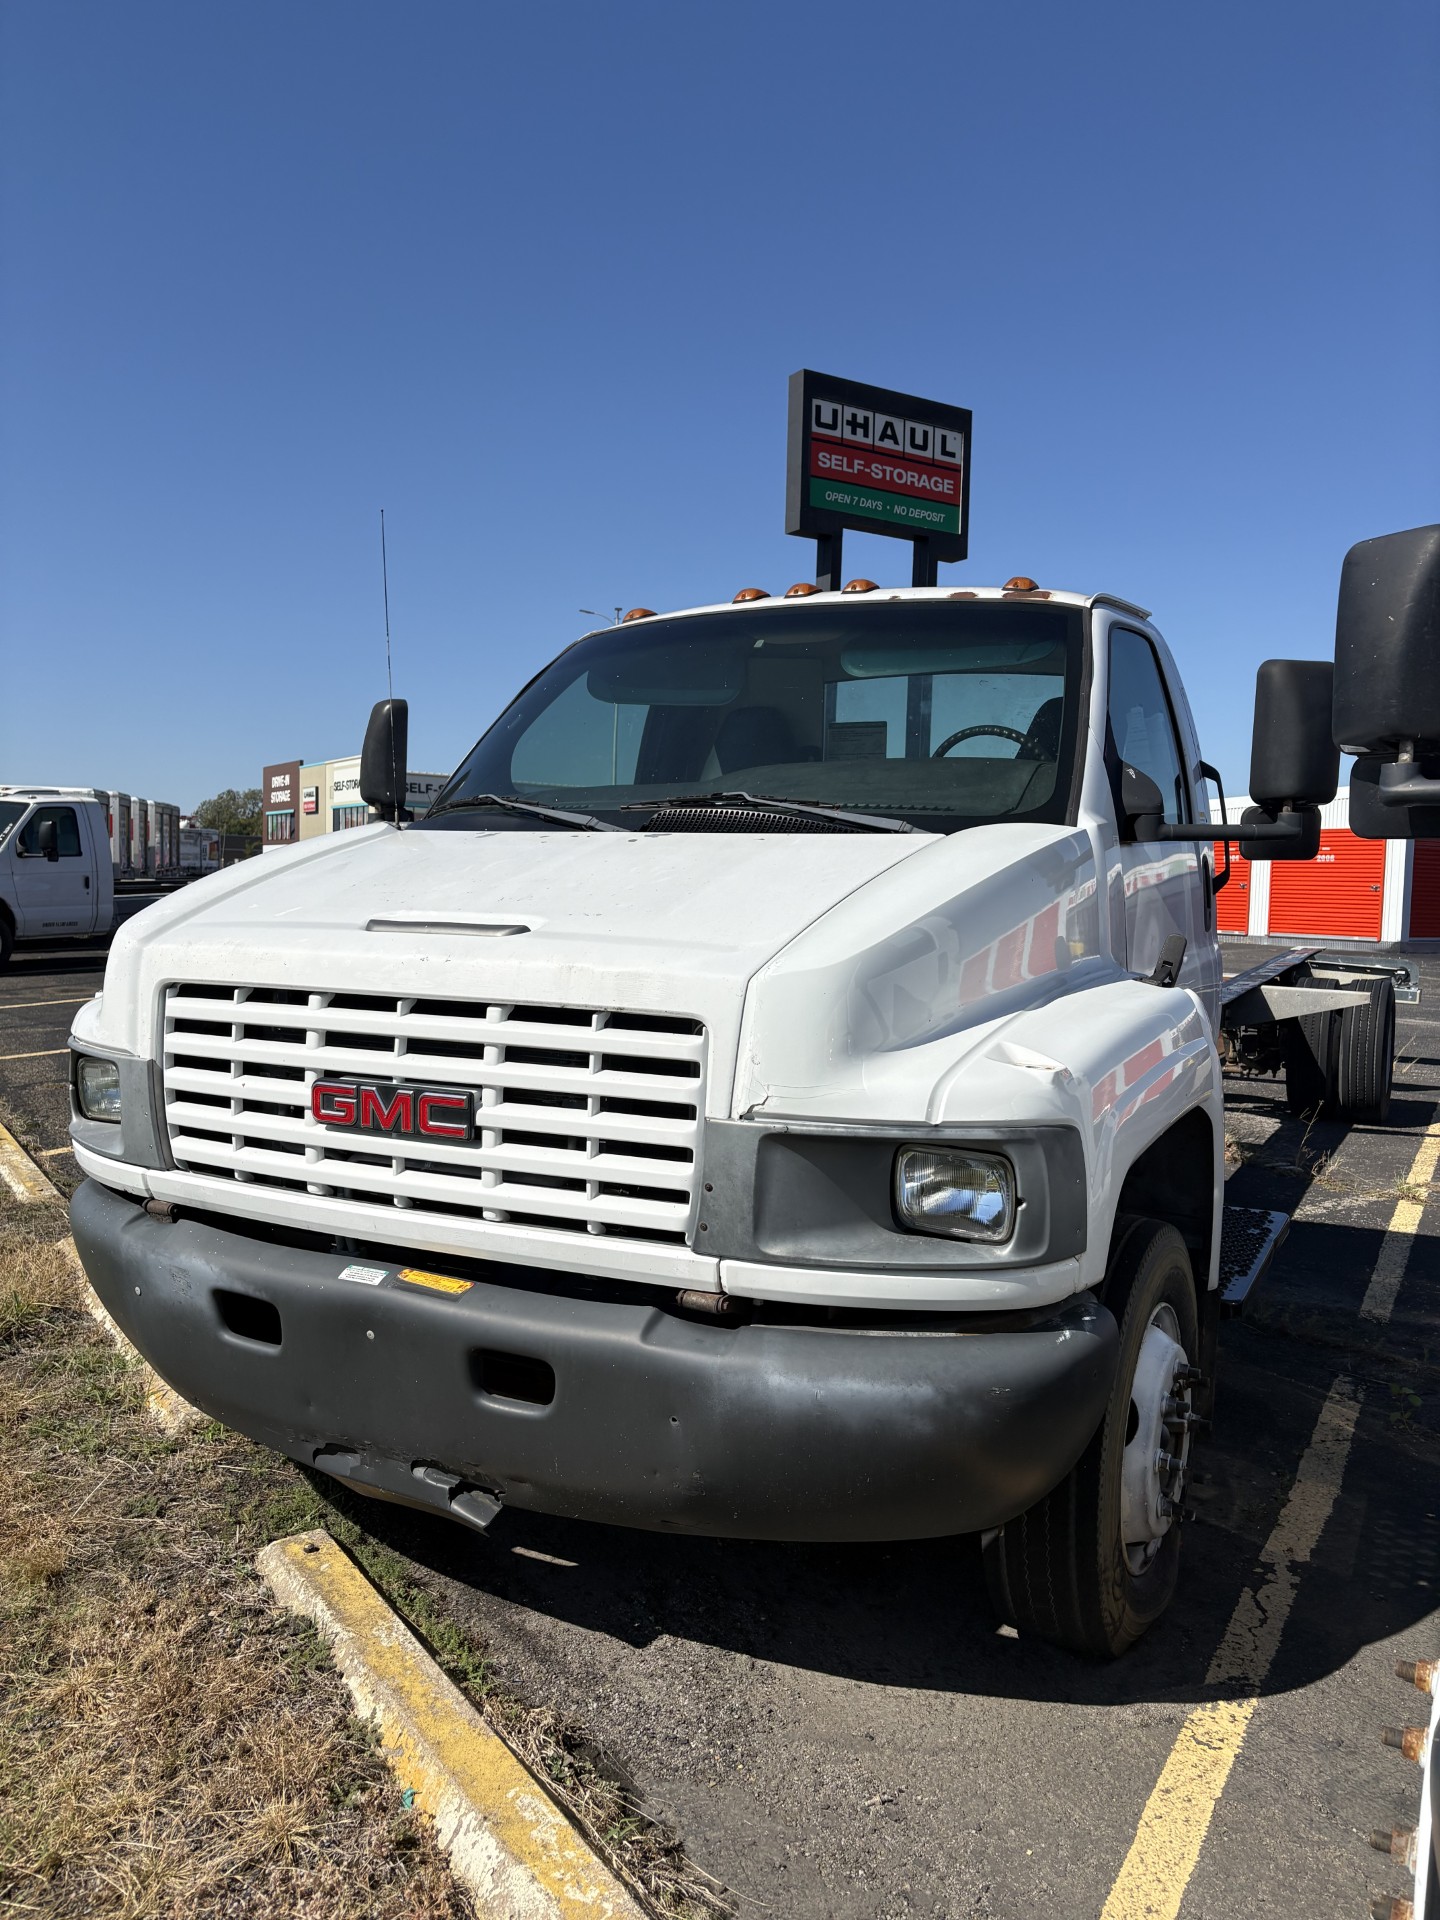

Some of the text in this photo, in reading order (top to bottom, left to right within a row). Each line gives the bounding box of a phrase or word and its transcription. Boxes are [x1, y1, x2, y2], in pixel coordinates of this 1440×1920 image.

[817, 452, 954, 494] SELF-STORAGE
[825, 491, 945, 523] OPEN 7 DAYS NO DEPOSIT
[270, 789, 291, 804] STORAGE
[311, 1081, 469, 1139] GMC
